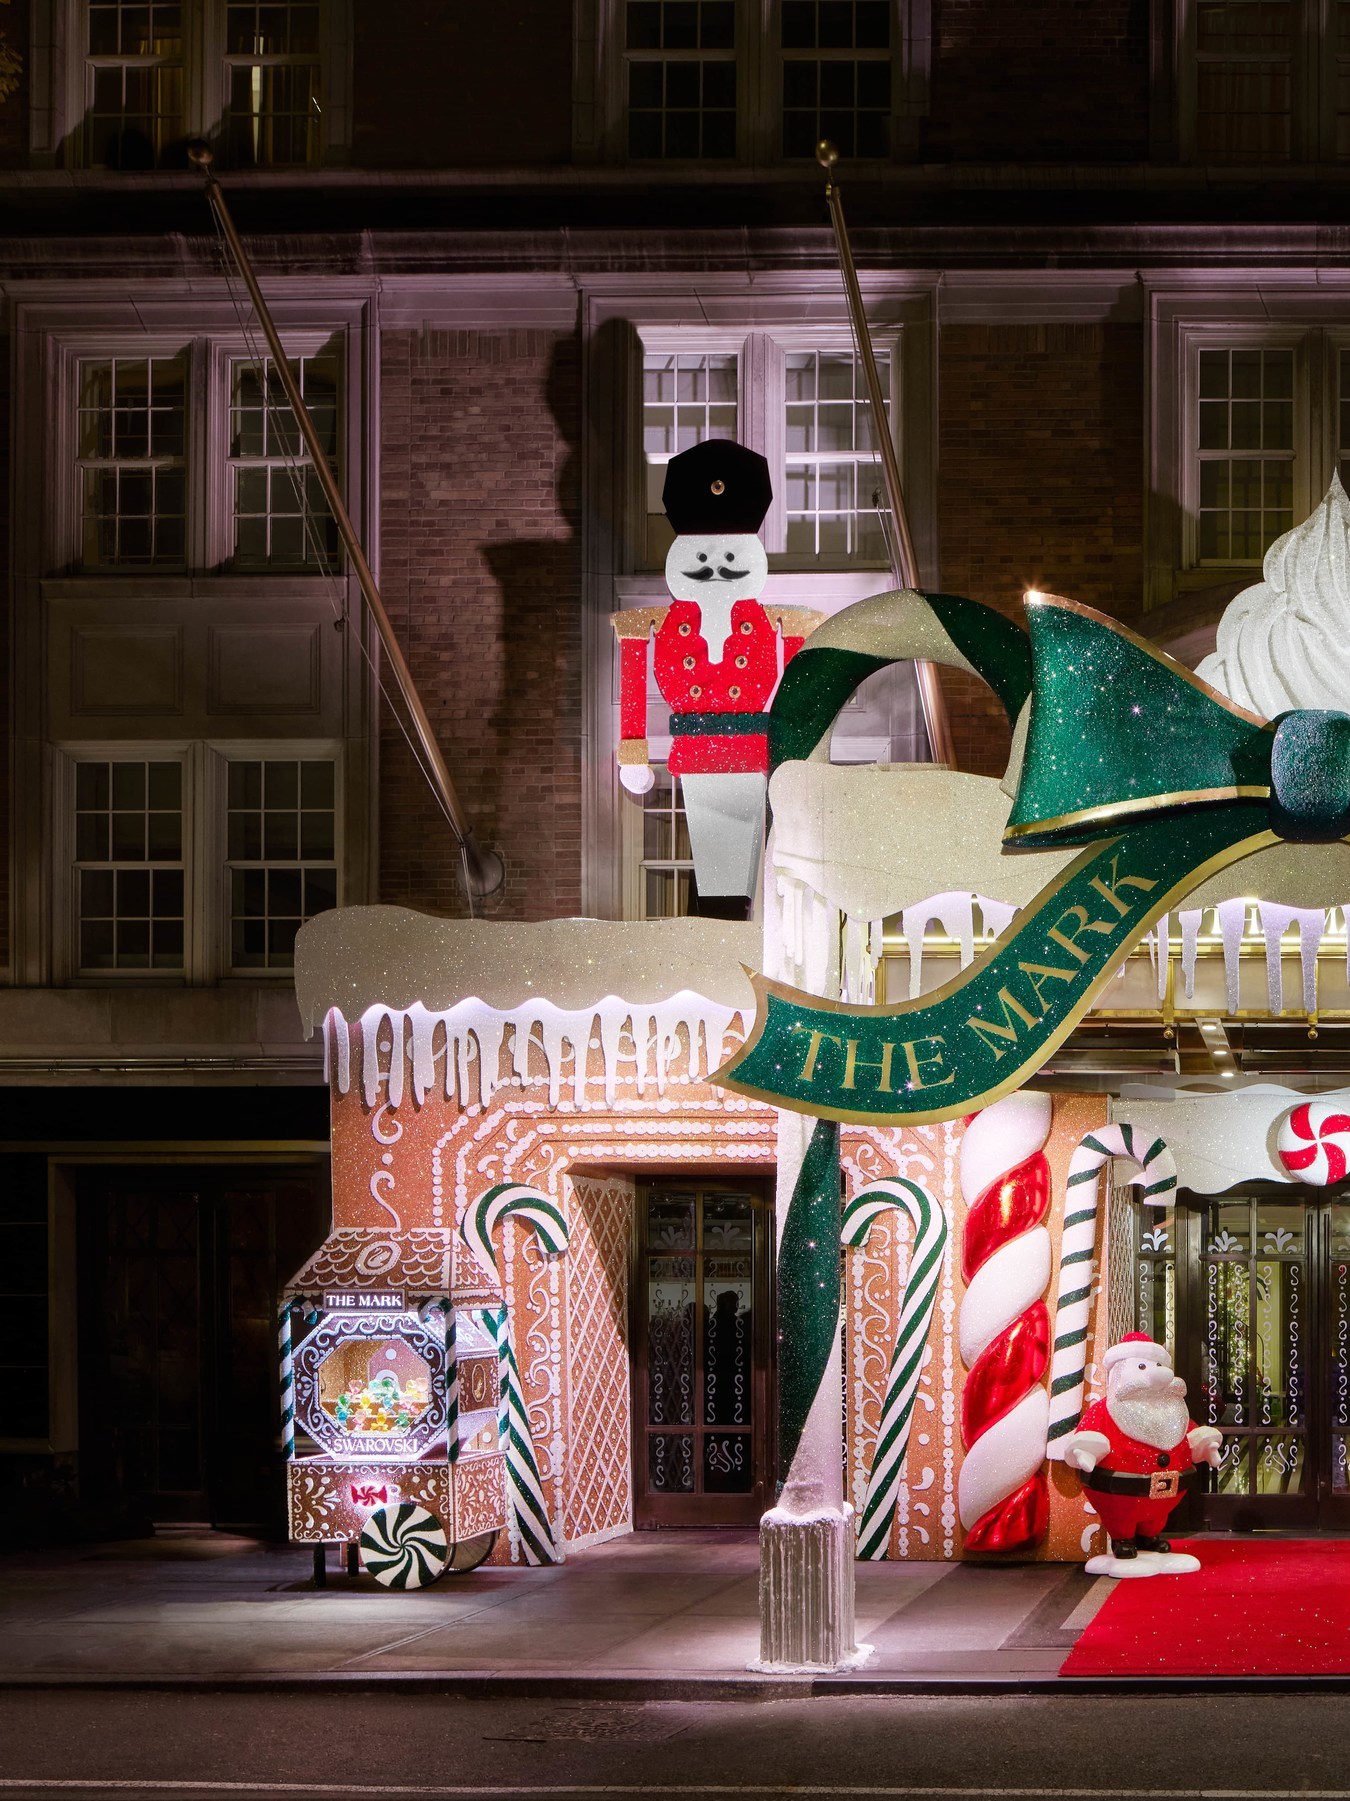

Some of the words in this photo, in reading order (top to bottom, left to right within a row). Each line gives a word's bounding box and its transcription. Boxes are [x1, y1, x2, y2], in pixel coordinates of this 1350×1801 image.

[790, 1026, 956, 1093] THE
[963, 853, 1160, 1062] MARK
[326, 1294, 356, 1307] THE
[359, 1294, 402, 1307] MARK
[333, 1438, 418, 1453] SWAROVSKI
